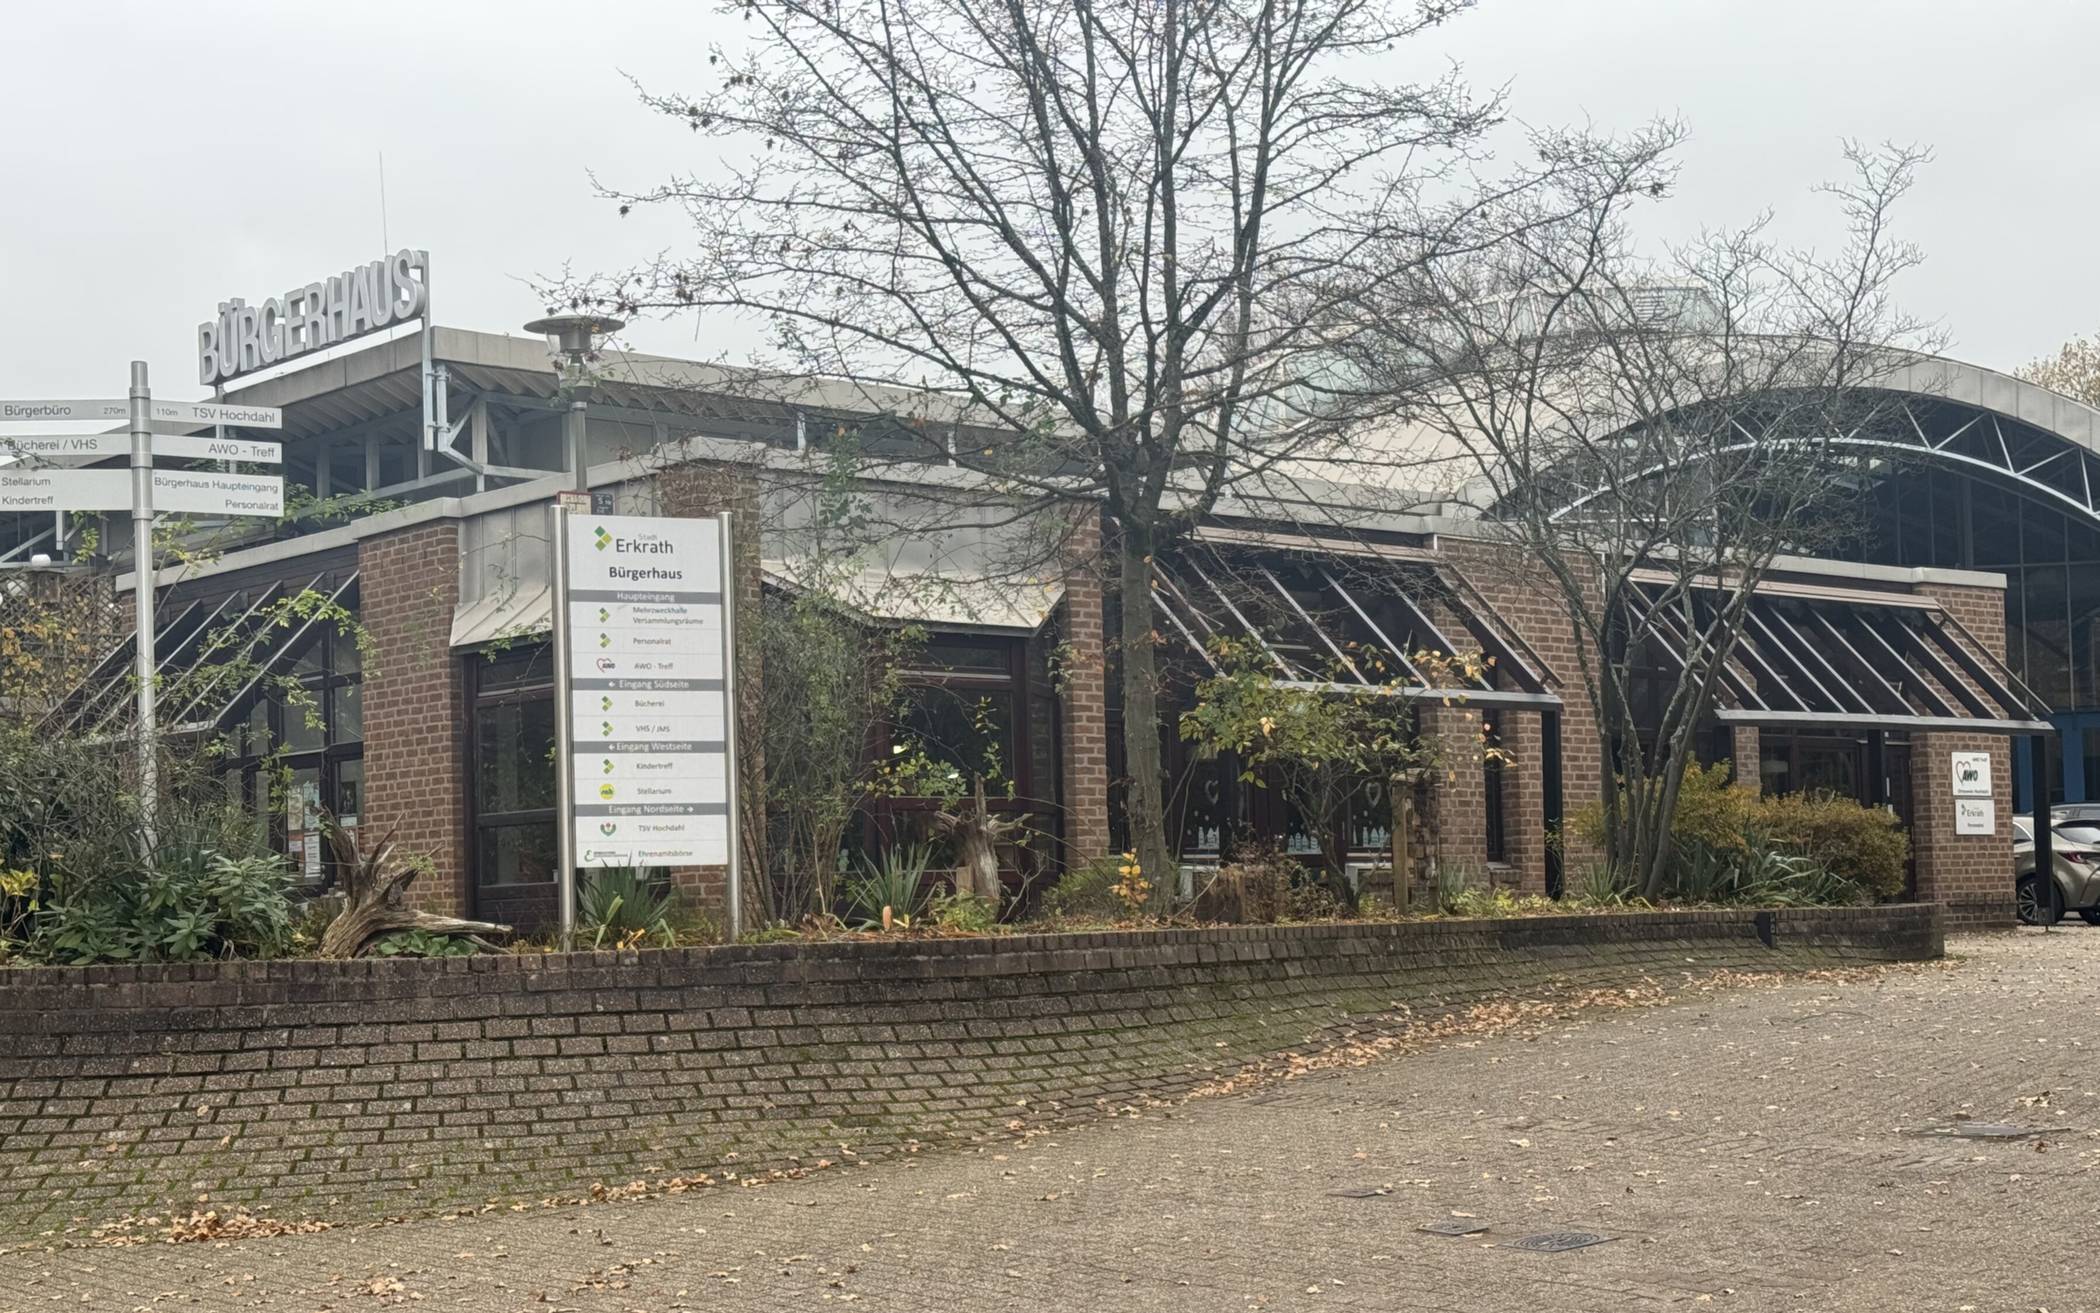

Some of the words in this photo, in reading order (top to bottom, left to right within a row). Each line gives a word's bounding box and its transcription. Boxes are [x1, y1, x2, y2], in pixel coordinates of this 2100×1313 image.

[198, 248, 425, 385] BÜRGERHAUS
[4, 405, 72, 418] Bürgerbüro
[103, 407, 127, 415] 270m
[156, 407, 178, 416] 110m
[192, 407, 217, 418] TSV
[220, 410, 275, 423] Hochdahl
[63, 440, 68, 450] /
[71, 439, 98, 450] VHS
[208, 443, 239, 455] AWO
[251, 446, 275, 457] Treff
[1, 477, 51, 487] Stellarium
[154, 477, 210, 489] Bürgerhaus
[212, 480, 279, 494] Haupteingang
[1, 496, 54, 505] Kindertreff
[225, 499, 279, 511] Personalrat
[615, 538, 674, 554] Erkrath
[609, 566, 683, 581] Bürgerhaus
[617, 592, 675, 603] Haupteingang
[632, 637, 672, 645] Personalrat
[658, 662, 674, 670] Treff
[619, 680, 652, 690] Eingang
[654, 680, 690, 689] Südseite
[634, 699, 665, 708] Bücherei
[616, 742, 649, 753] Eingang
[651, 742, 692, 751] Westseite
[636, 762, 673, 770] Kindertreff
[1962, 769, 1978, 782] AWO
[637, 787, 672, 795] Stellarium
[608, 805, 641, 815] Eingang
[644, 805, 684, 813] Nordseite
[638, 824, 651, 832] TSV
[652, 824, 685, 832] Hochdahl
